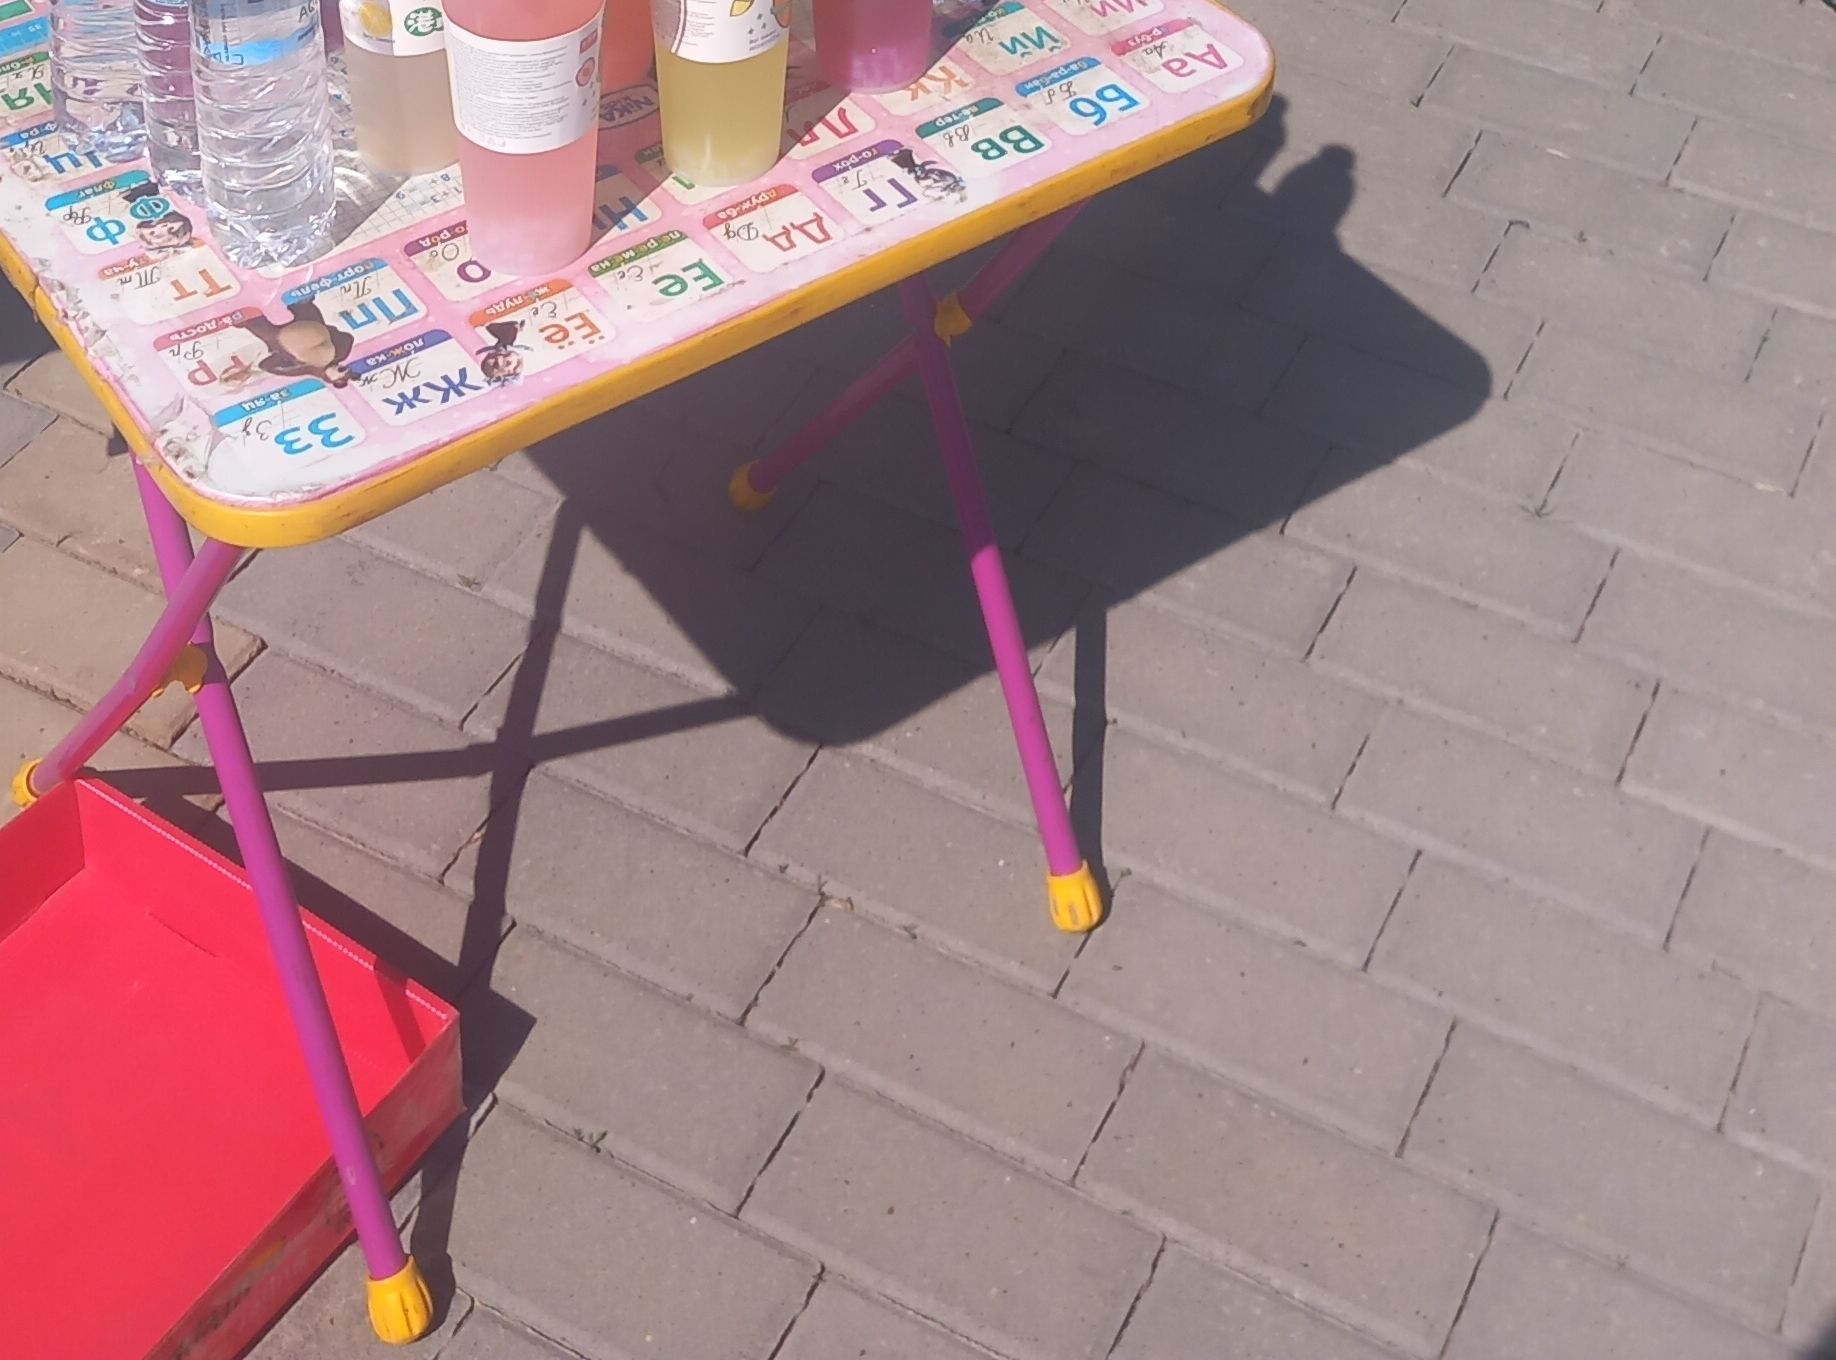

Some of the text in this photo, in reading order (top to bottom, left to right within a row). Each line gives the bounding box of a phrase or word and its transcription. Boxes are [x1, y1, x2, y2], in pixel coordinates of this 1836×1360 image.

[998, 25, 1061, 59] Йй
[1161, 43, 1229, 77] Аа
[1069, 83, 1141, 127] Бб
[971, 125, 1045, 161] Вв
[863, 177, 918, 212] Гг
[763, 212, 833, 253] Дд
[171, 268, 233, 302] Тт
[651, 258, 725, 297] Ее
[339, 288, 418, 330] Пп
[538, 312, 606, 350] Ёё
[382, 366, 483, 416] Жж
[274, 412, 355, 455] Зз
